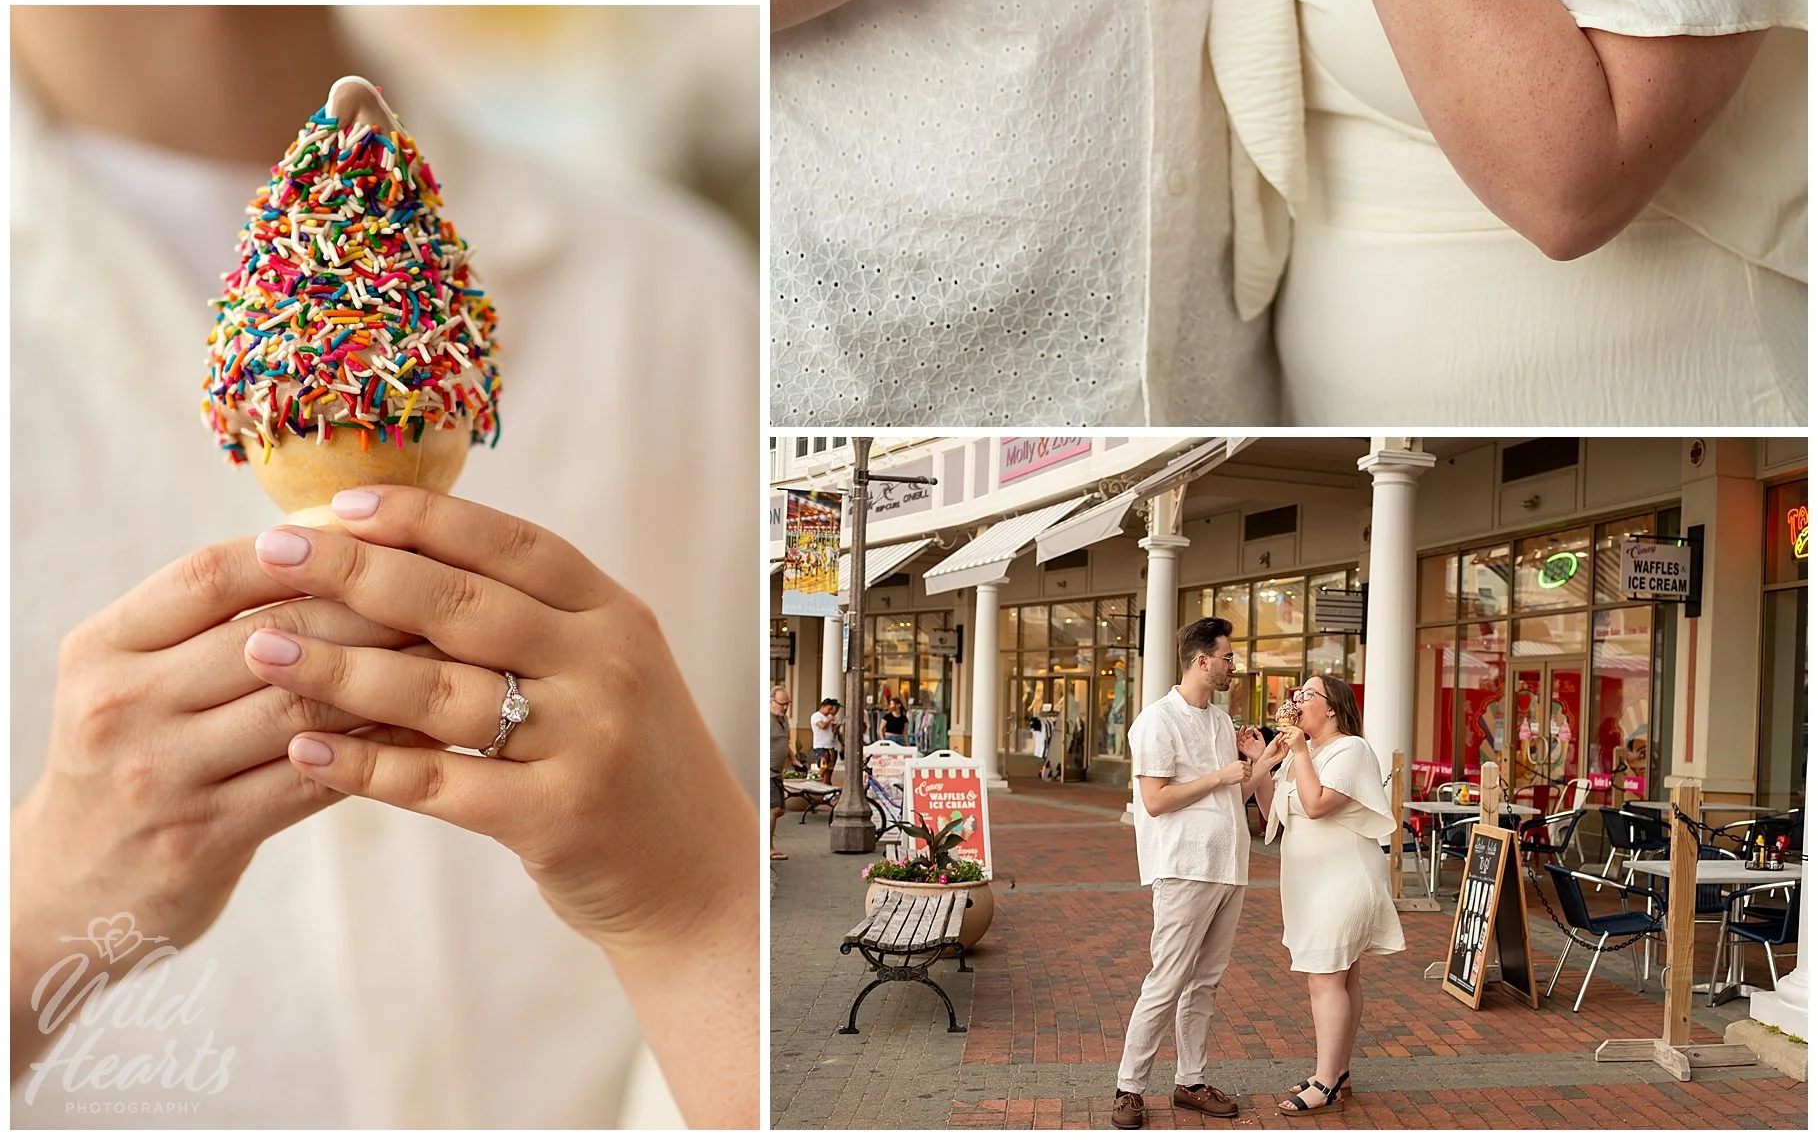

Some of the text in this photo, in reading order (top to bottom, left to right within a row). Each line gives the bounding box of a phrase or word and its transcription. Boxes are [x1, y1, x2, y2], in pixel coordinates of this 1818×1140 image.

[1006, 439, 1036, 467] Molly
[1626, 544, 1656, 559] Coney
[1633, 560, 1680, 576] WAFFLES
[1628, 576, 1687, 592] ICE CREAM
[914, 780, 944, 797] Coney
[928, 790, 978, 801] WAFFLES &
[928, 801, 976, 809] ICE CREAM
